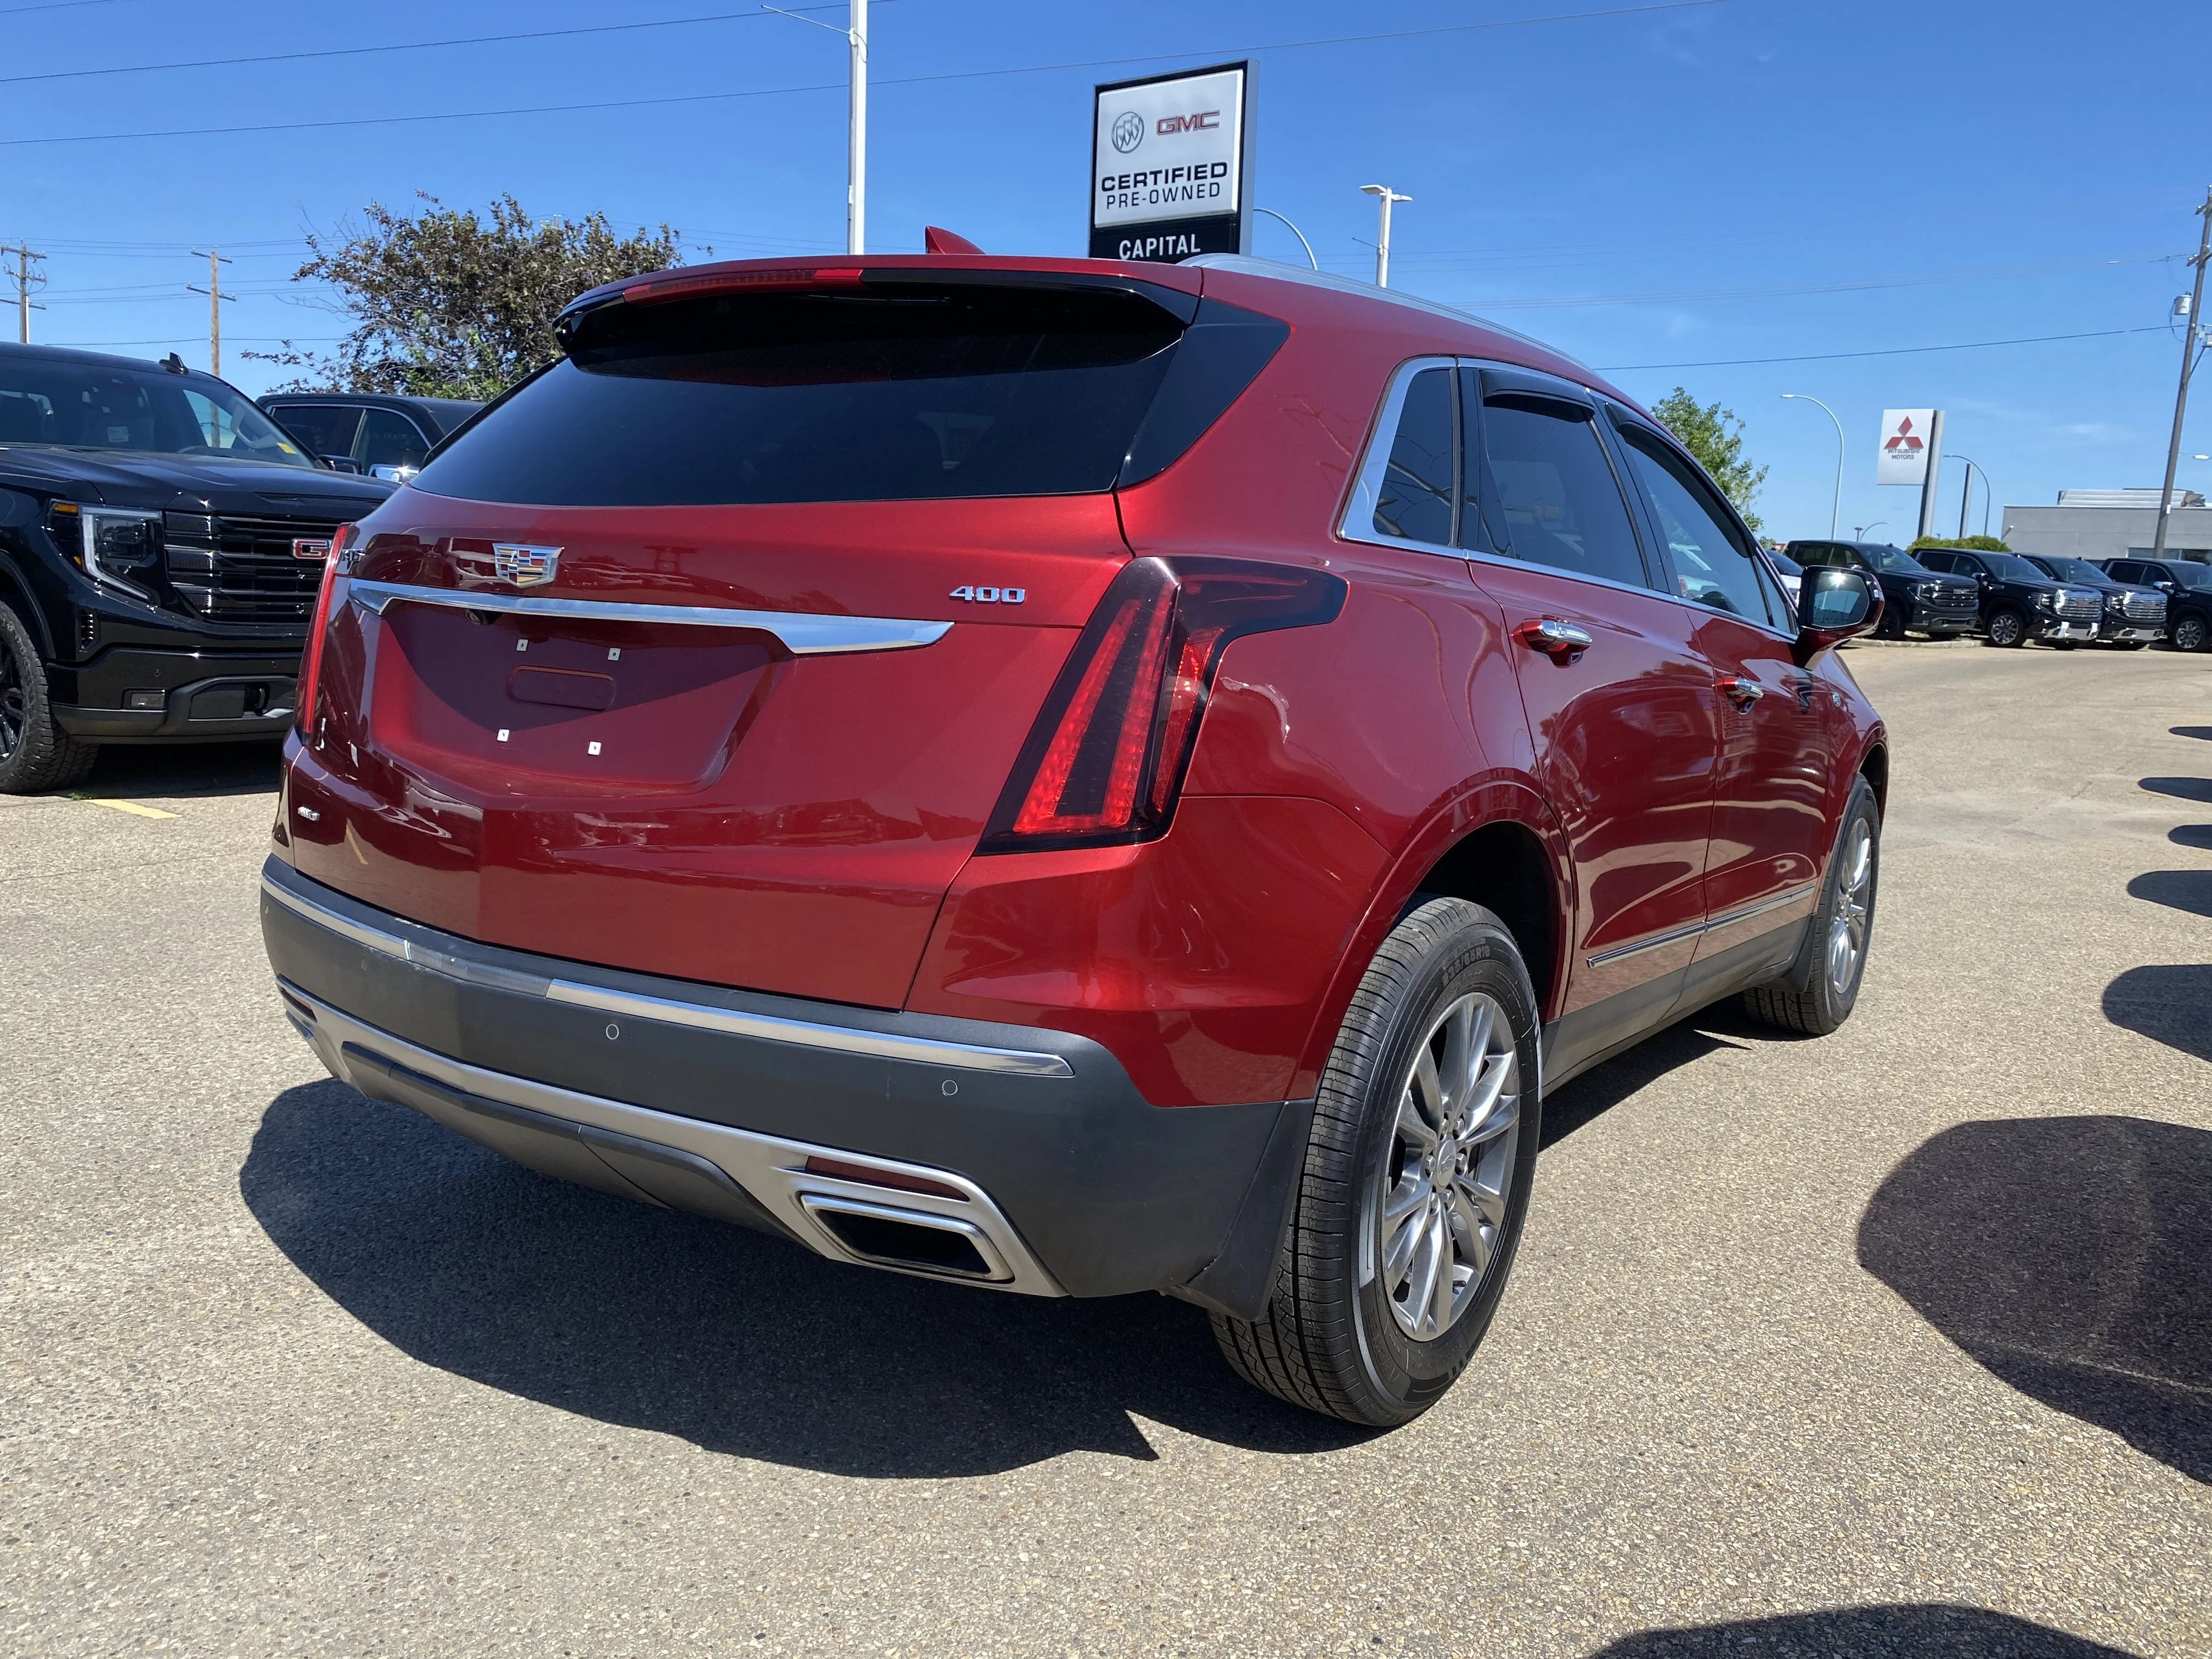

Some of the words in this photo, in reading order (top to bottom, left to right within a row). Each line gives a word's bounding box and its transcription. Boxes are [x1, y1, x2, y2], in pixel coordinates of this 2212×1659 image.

[1156, 110, 1220, 136] GMC
[1102, 161, 1228, 192] CERTIFIED
[1107, 182, 1220, 210] PRE-OWNED
[1119, 234, 1201, 260] CAPITAL
[950, 585, 1025, 603] 400
